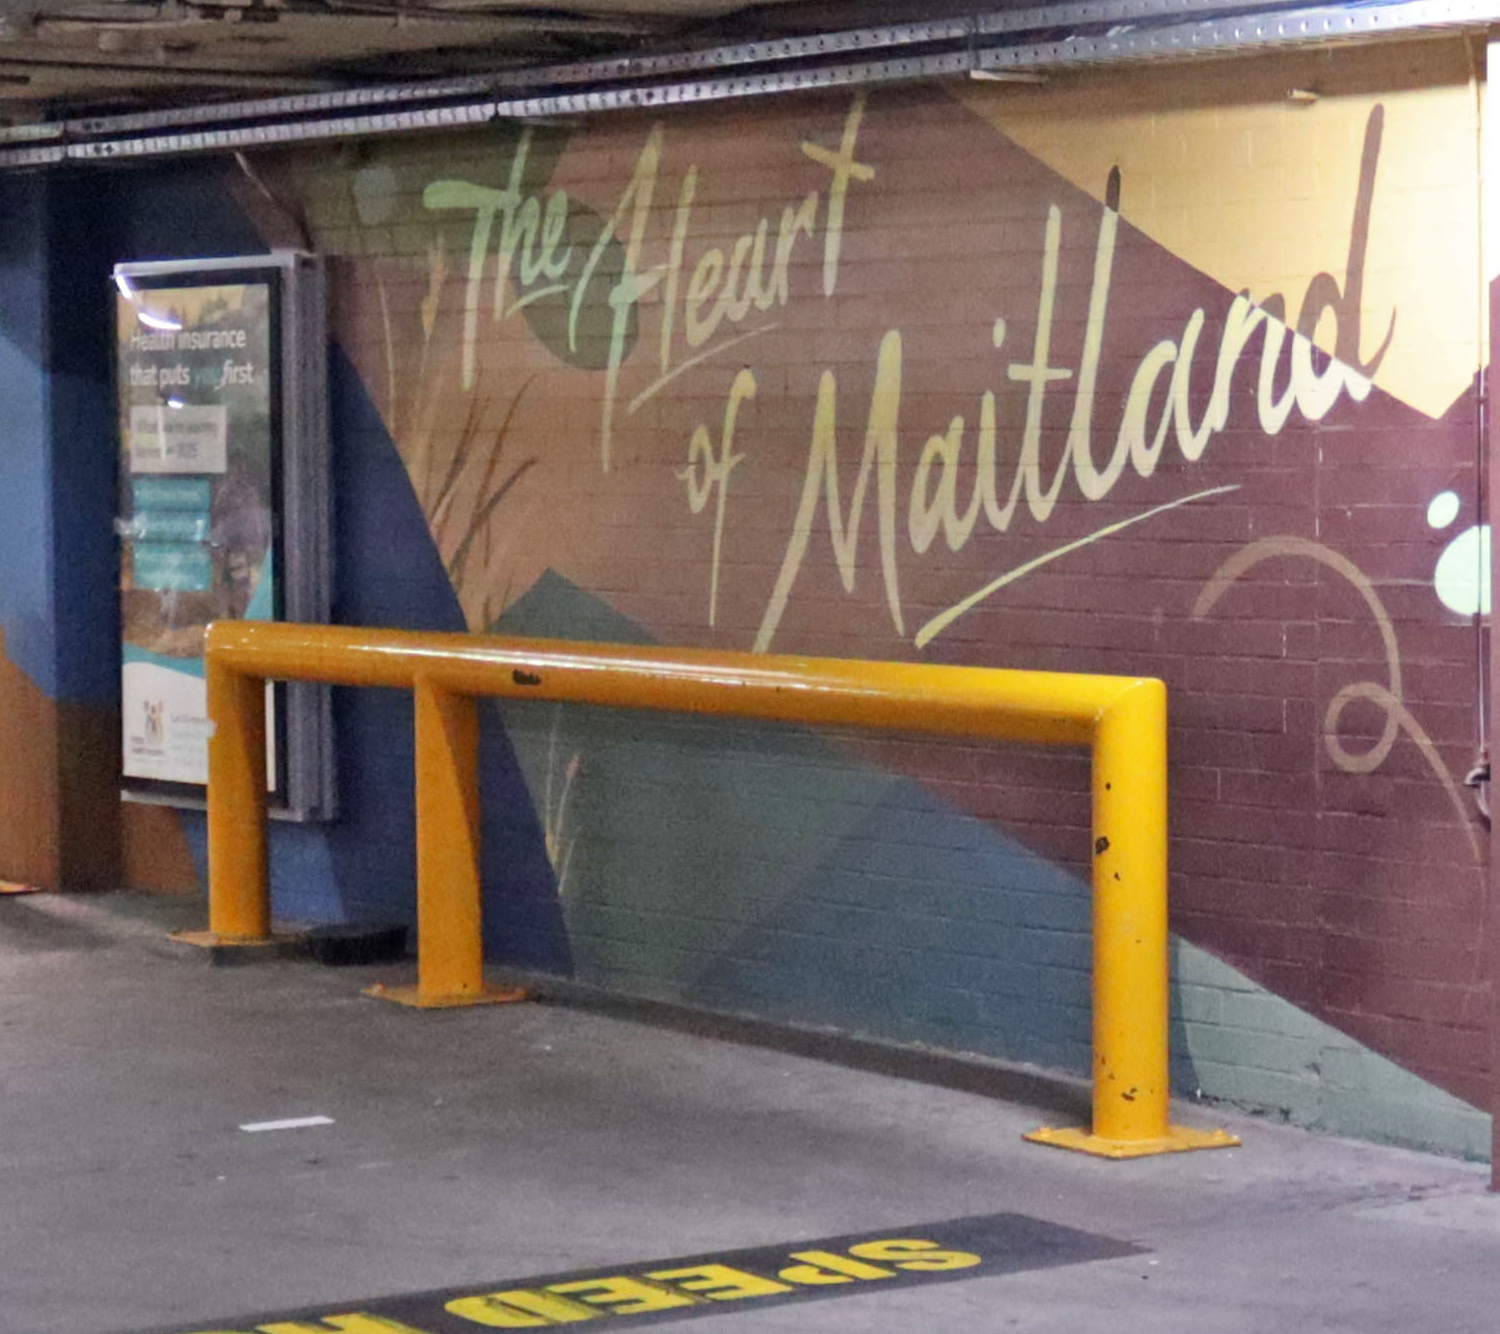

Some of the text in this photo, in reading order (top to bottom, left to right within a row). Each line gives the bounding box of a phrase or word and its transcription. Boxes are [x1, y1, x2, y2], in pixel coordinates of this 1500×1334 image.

[422, 95, 876, 474] The Heart
[129, 363, 158, 386] that
[159, 362, 191, 387] puts
[213, 359, 256, 391] first
[177, 328, 247, 351] insurance
[672, 102, 1397, 655] of Maitland
[443, 1238, 983, 1330] SPEED
